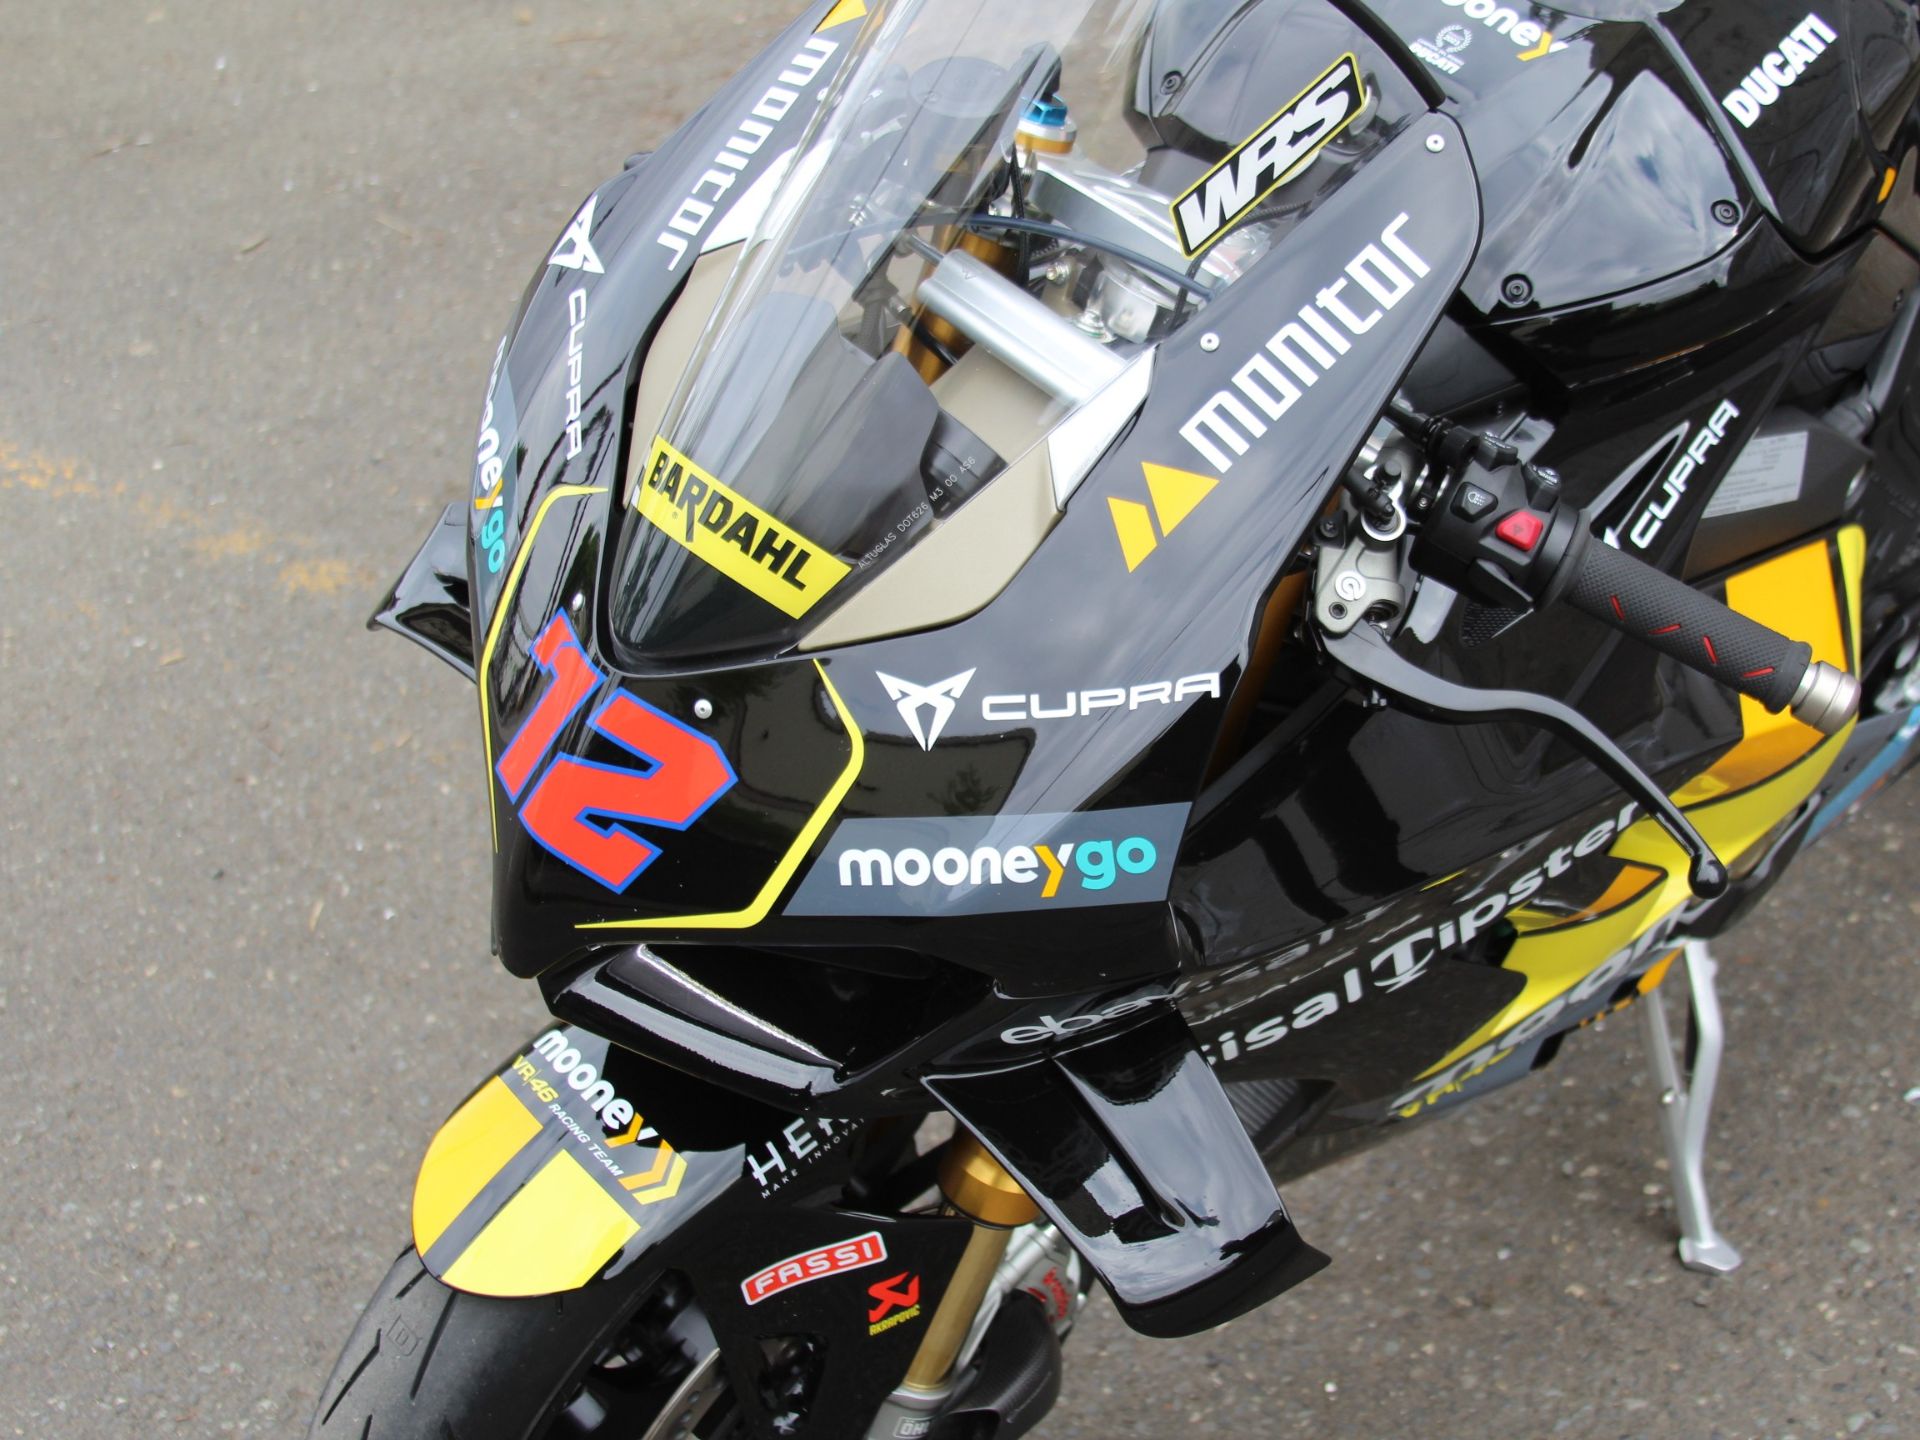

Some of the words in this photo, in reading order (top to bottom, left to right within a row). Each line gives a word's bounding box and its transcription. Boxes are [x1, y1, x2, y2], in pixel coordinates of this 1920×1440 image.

[1441, 0, 1569, 62] oney
[1722, 13, 1838, 129] DUCATI
[1178, 63, 1353, 252] WRS
[567, 288, 588, 461] CUPRA
[648, 451, 812, 592] BARDAHL
[858, 532, 897, 569] ALTUGLAS
[896, 501, 929, 533] DOT626
[929, 487, 944, 502] M3
[959, 456, 976, 473] AS6
[1629, 398, 1741, 549] CUPRA
[495, 606, 739, 895] 12
[981, 671, 1222, 721] CUPRA
[838, 837, 1158, 899] mooneygo
[532, 1029, 660, 1149] mooney
[548, 1102, 591, 1144] RACING
[588, 1142, 625, 1177] TEAM
[761, 1168, 799, 1199] MAKE
[755, 1241, 875, 1295] FASSI
